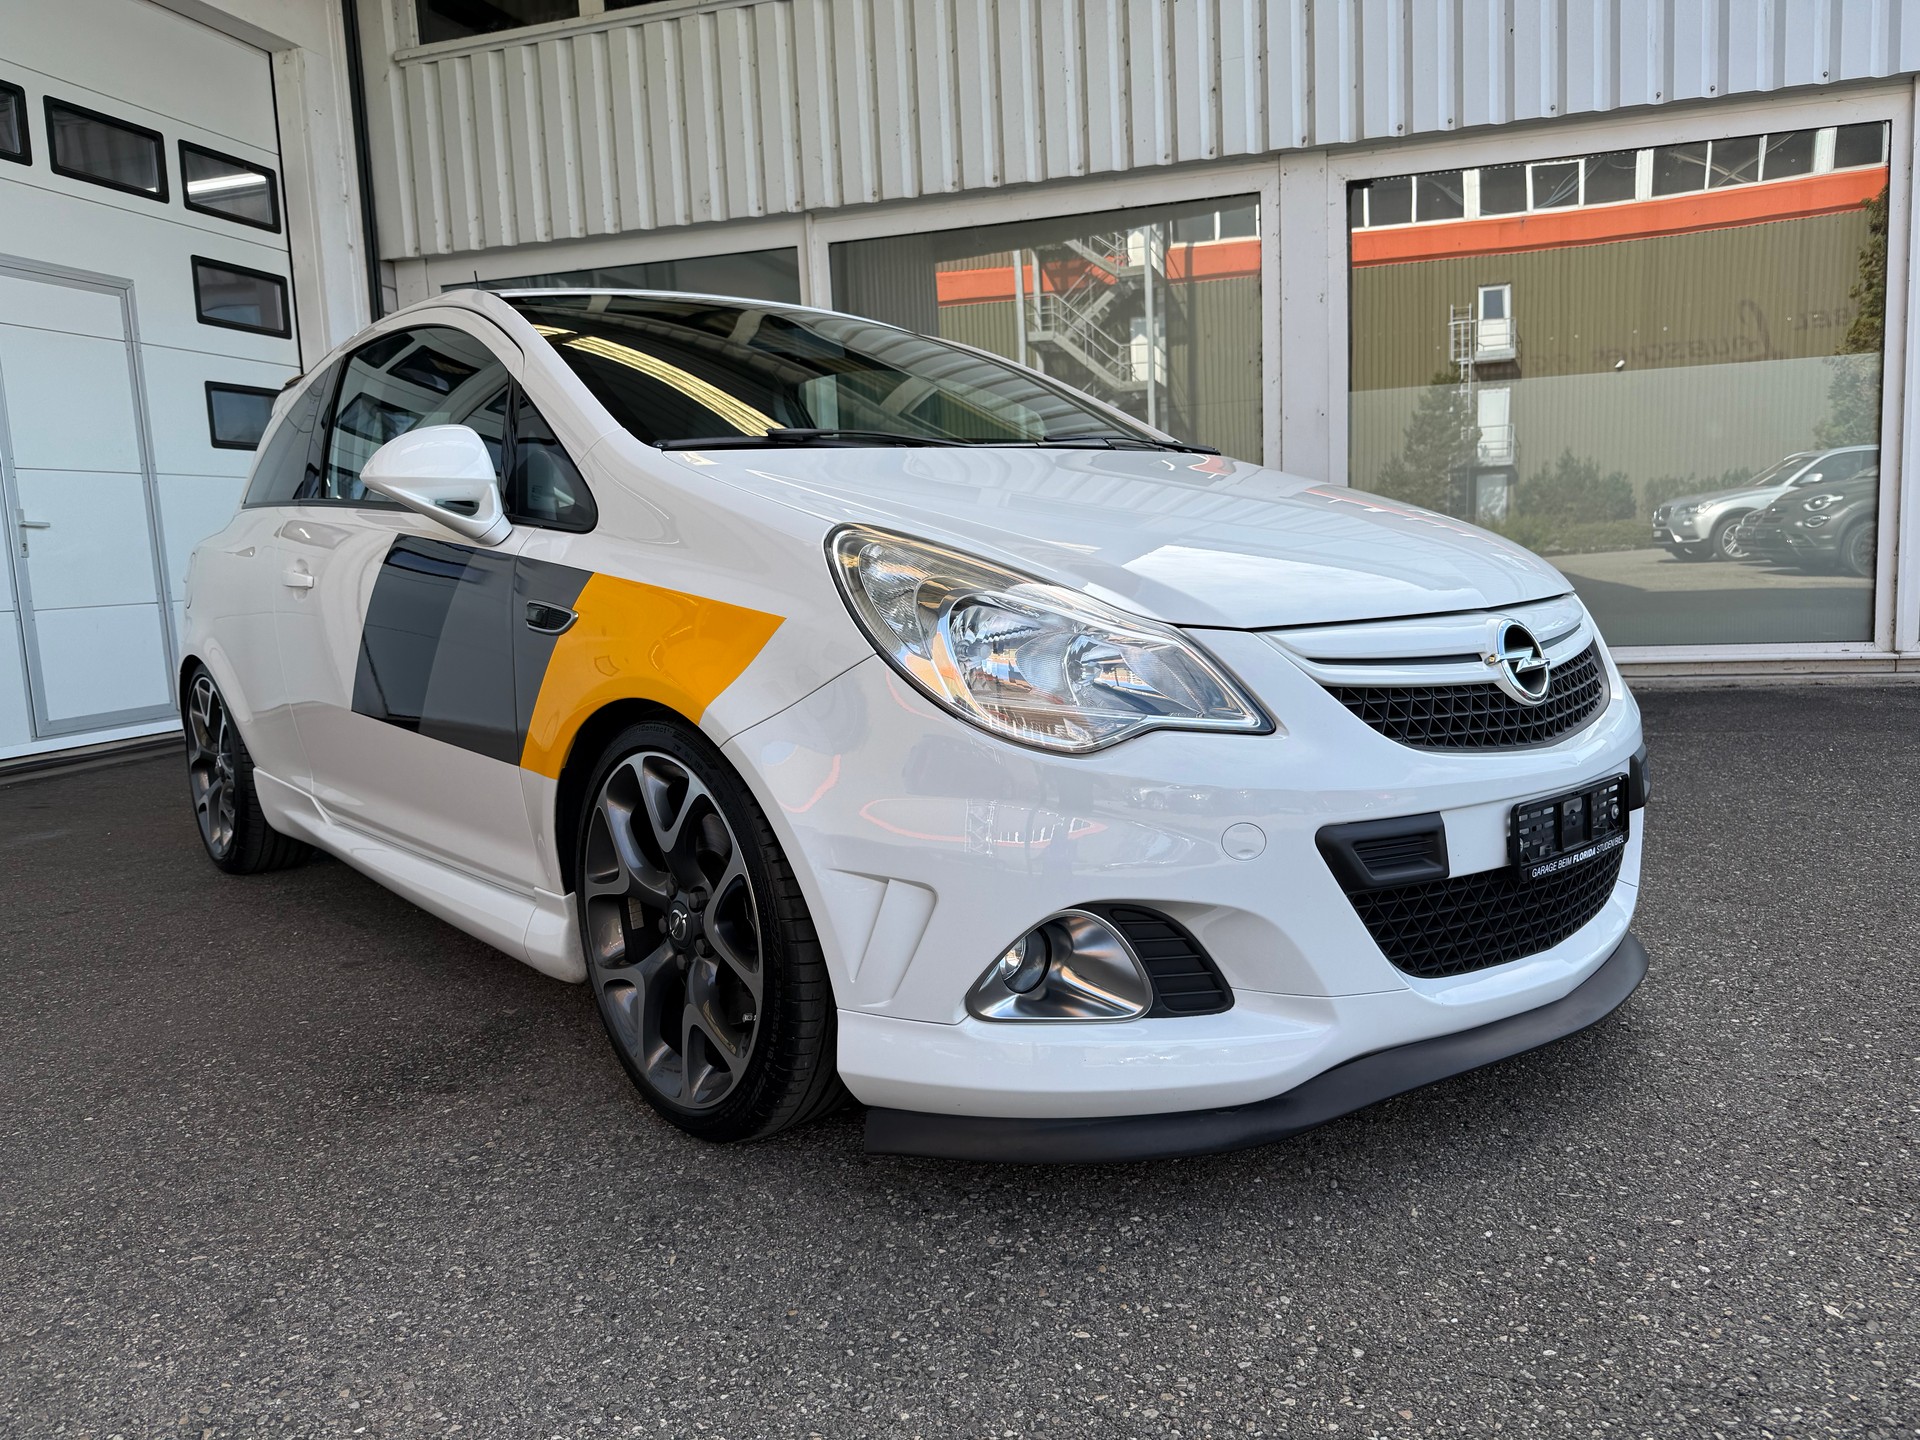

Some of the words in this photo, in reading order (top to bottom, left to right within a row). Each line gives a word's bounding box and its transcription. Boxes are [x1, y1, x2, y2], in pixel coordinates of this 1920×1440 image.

[1532, 861, 1557, 877] GARAGE
[1558, 856, 1573, 869] BEIM
[1573, 847, 1596, 863] FLORIDA
